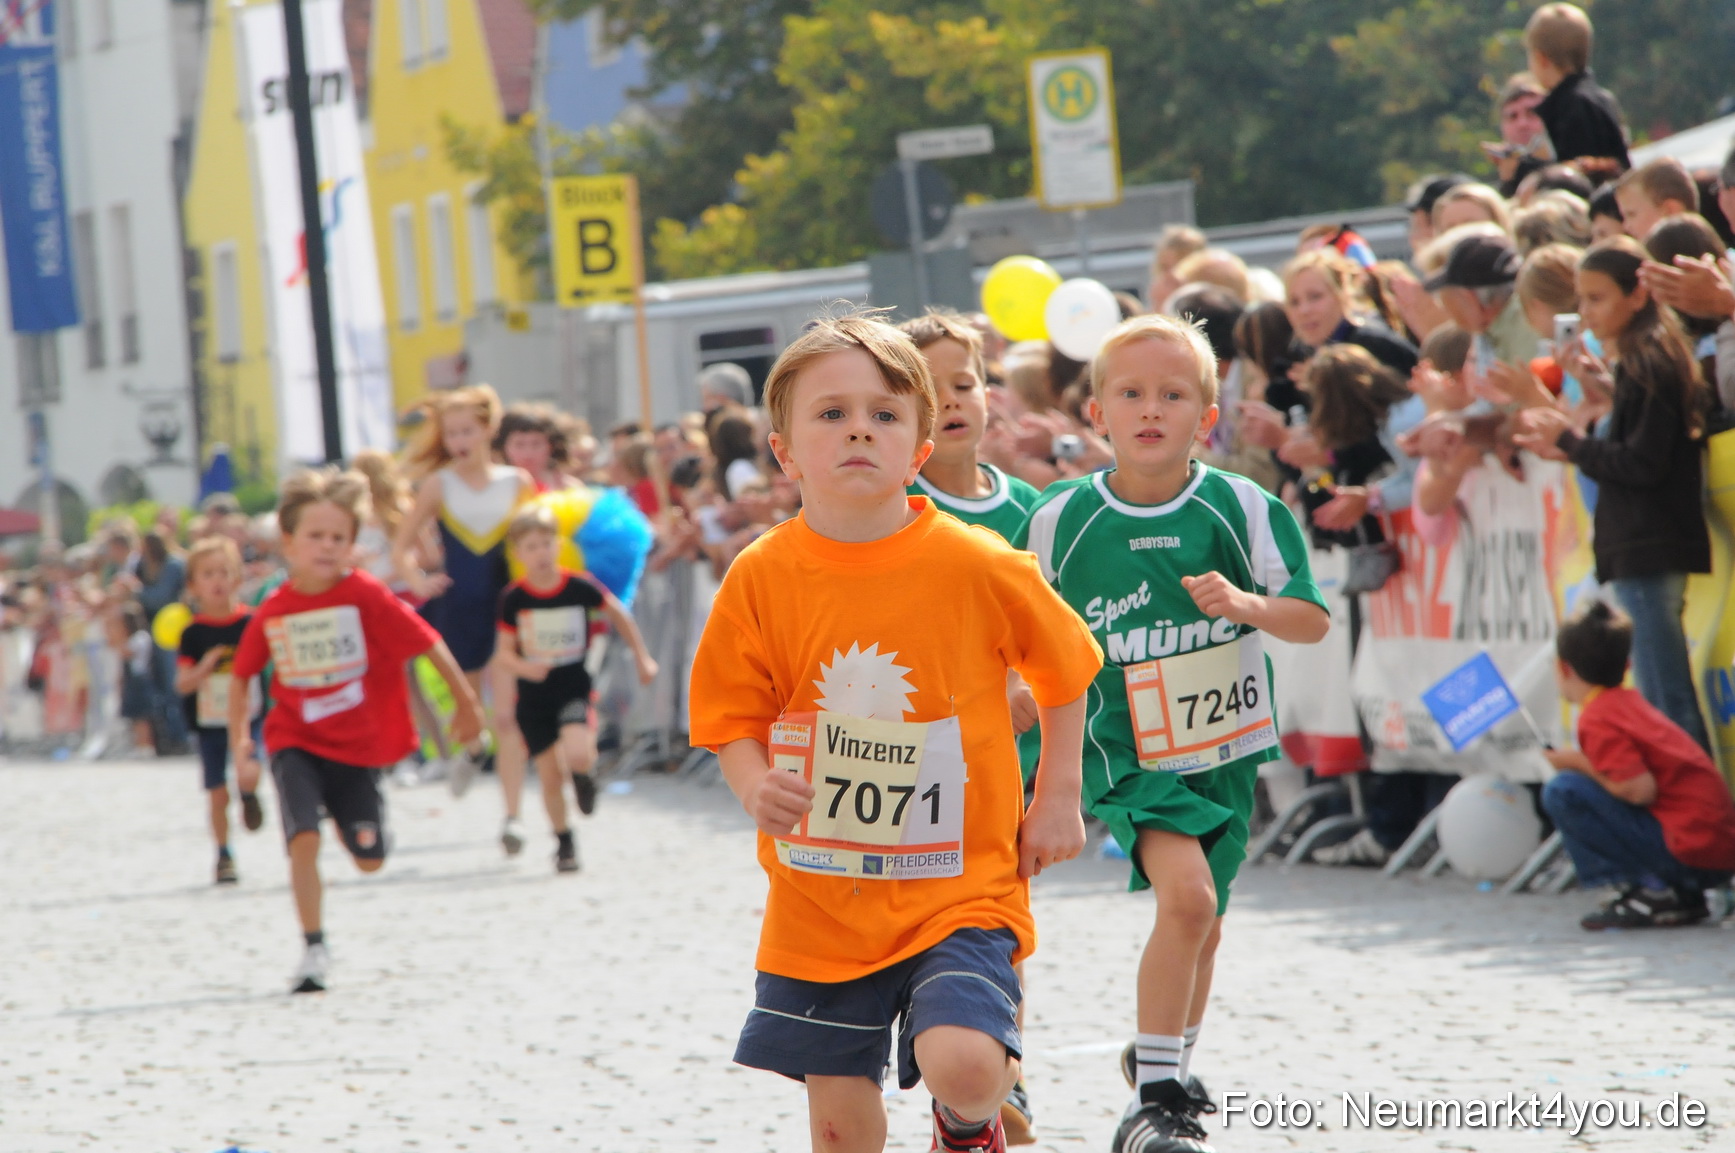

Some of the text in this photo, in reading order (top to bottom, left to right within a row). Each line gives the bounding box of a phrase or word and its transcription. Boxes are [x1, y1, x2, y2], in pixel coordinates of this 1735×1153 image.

[17, 57, 58, 211] RUPPERT
[578, 218, 617, 275] B
[1129, 536, 1180, 551] DERBYSTAR
[1085, 580, 1151, 632] Sport
[297, 634, 358, 664] 7035
[1106, 619, 1242, 664] Münc
[1177, 674, 1259, 730] 7246
[826, 723, 917, 765] Vinzenz
[824, 775, 941, 827] 7071
[886, 852, 959, 868] PFLEIDERER
